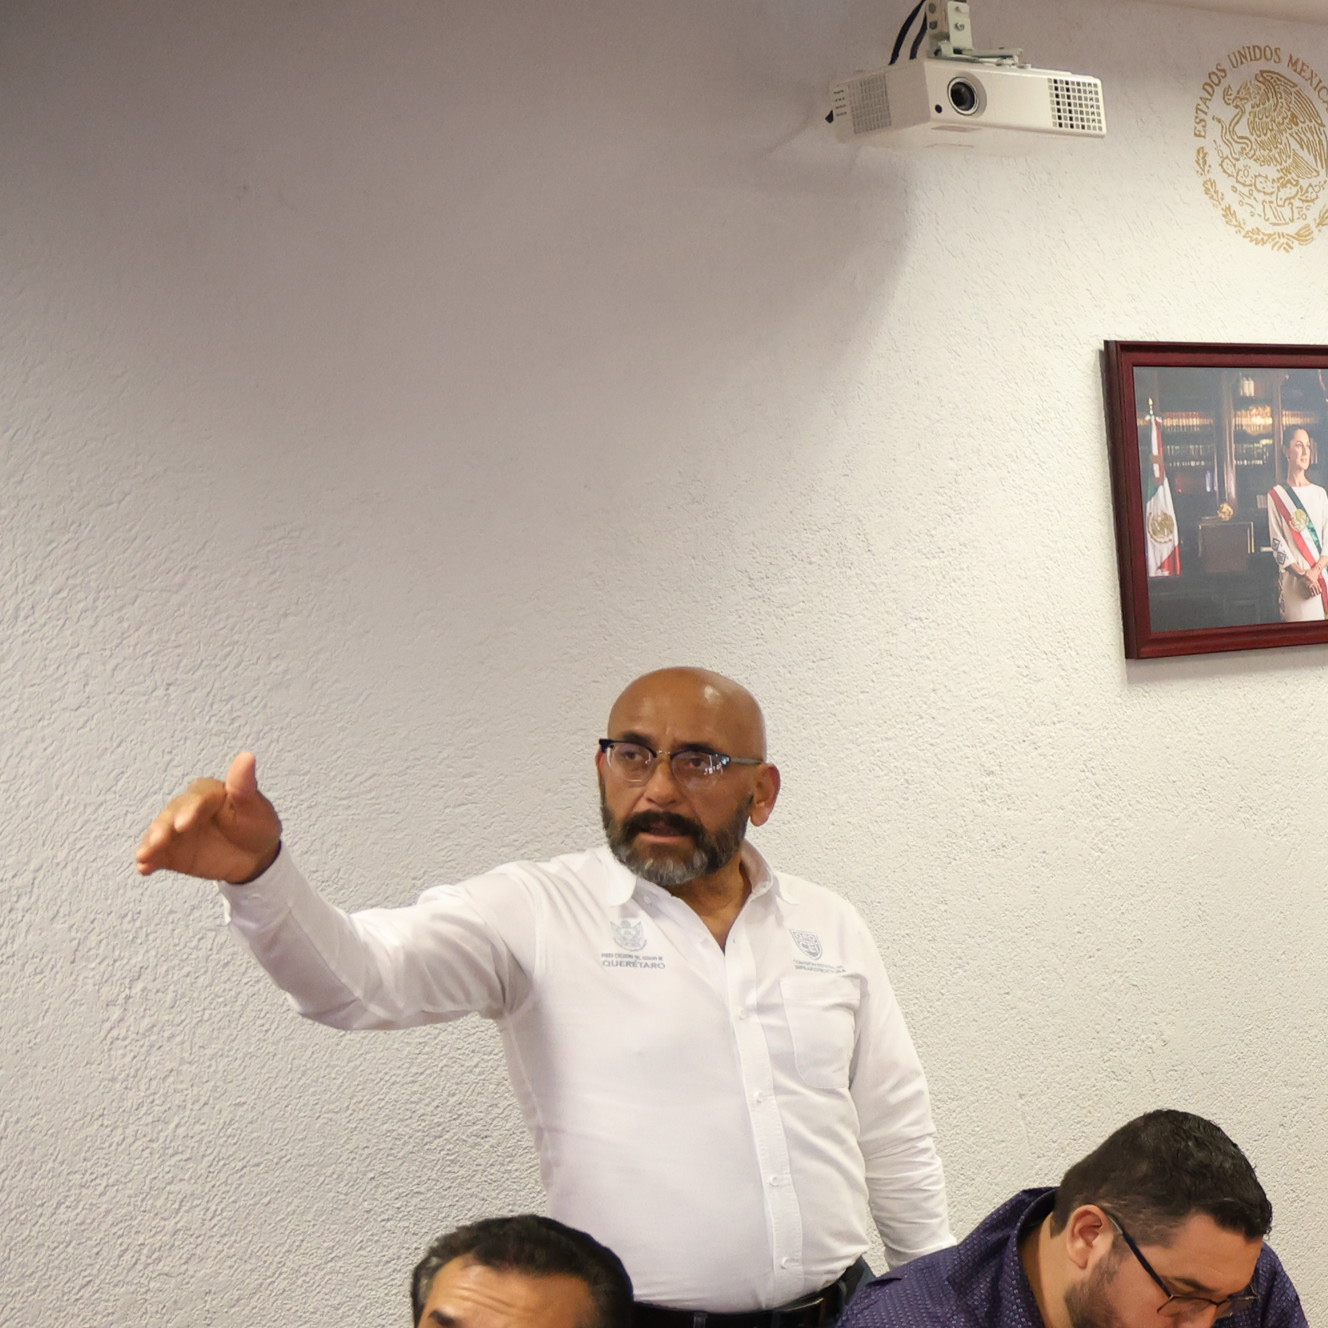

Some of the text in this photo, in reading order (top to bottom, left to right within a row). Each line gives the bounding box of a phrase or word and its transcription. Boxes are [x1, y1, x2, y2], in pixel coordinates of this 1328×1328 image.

[1193, 63, 1228, 139] ESTADOS
[1228, 45, 1282, 69] UNIDOS
[602, 959, 666, 970] QUERÉTARO
